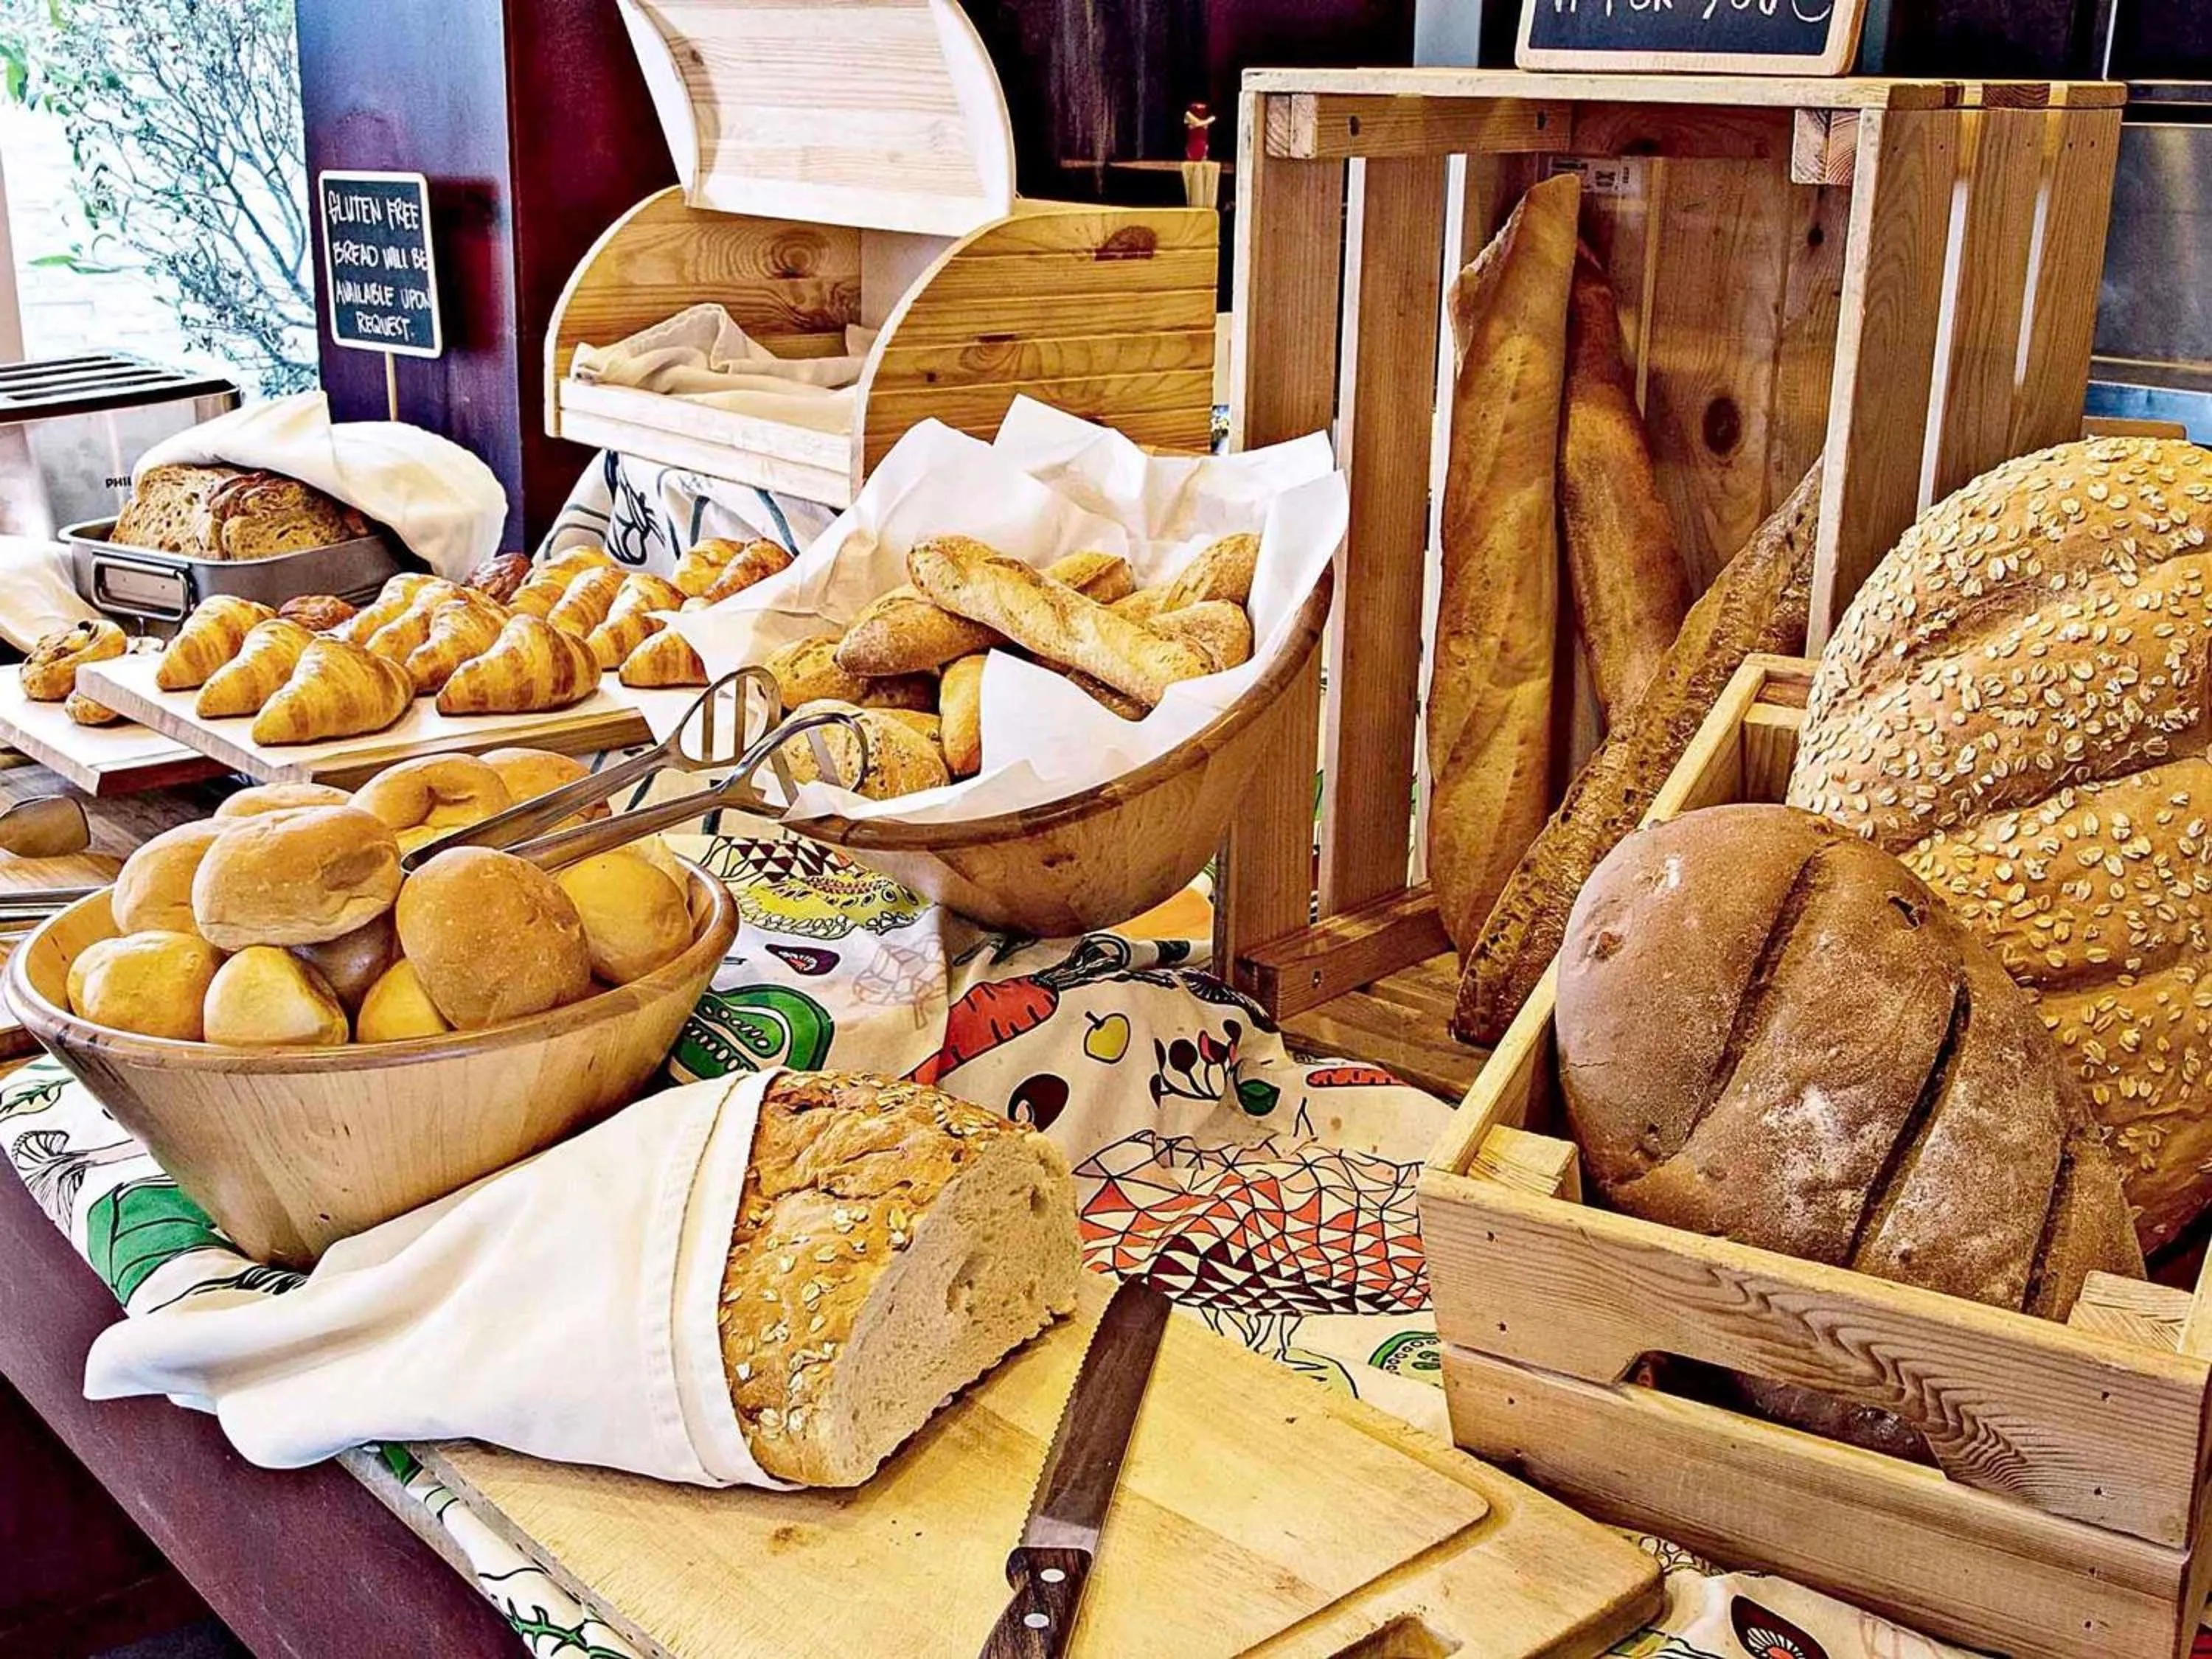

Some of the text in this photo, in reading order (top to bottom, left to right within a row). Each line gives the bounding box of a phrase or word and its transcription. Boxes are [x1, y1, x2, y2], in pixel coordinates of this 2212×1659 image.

[328, 190, 419, 230] GLUTEN FREE
[333, 240, 428, 271] BREAD WILL BE
[336, 279, 432, 310] AVAILABLE UPON
